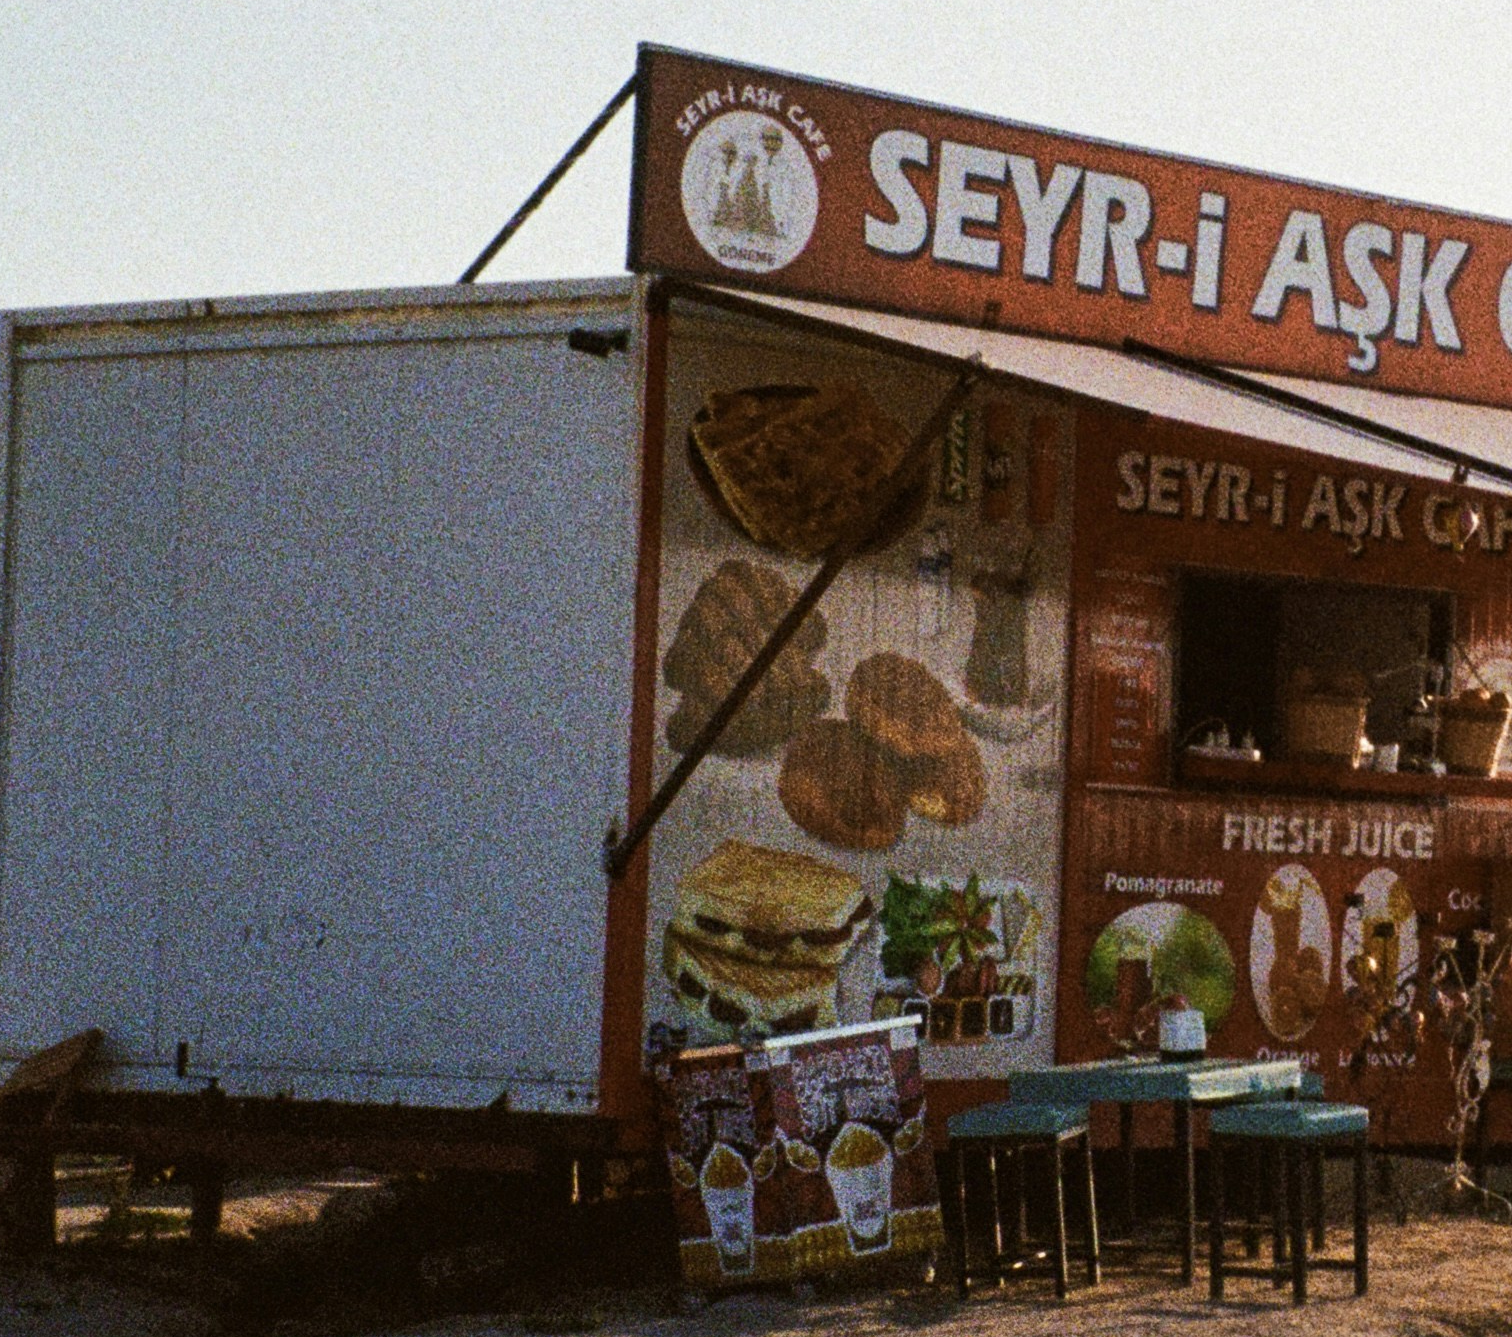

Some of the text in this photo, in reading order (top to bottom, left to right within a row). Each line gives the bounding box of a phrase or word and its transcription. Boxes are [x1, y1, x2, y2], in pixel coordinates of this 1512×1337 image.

[787, 105, 833, 162] CAFE
[1251, 210, 1469, 370] AŞK
[1301, 476, 1407, 556] AŞK
[1222, 814, 1332, 855] FRESH
[1104, 871, 1224, 899] Pomagranate
